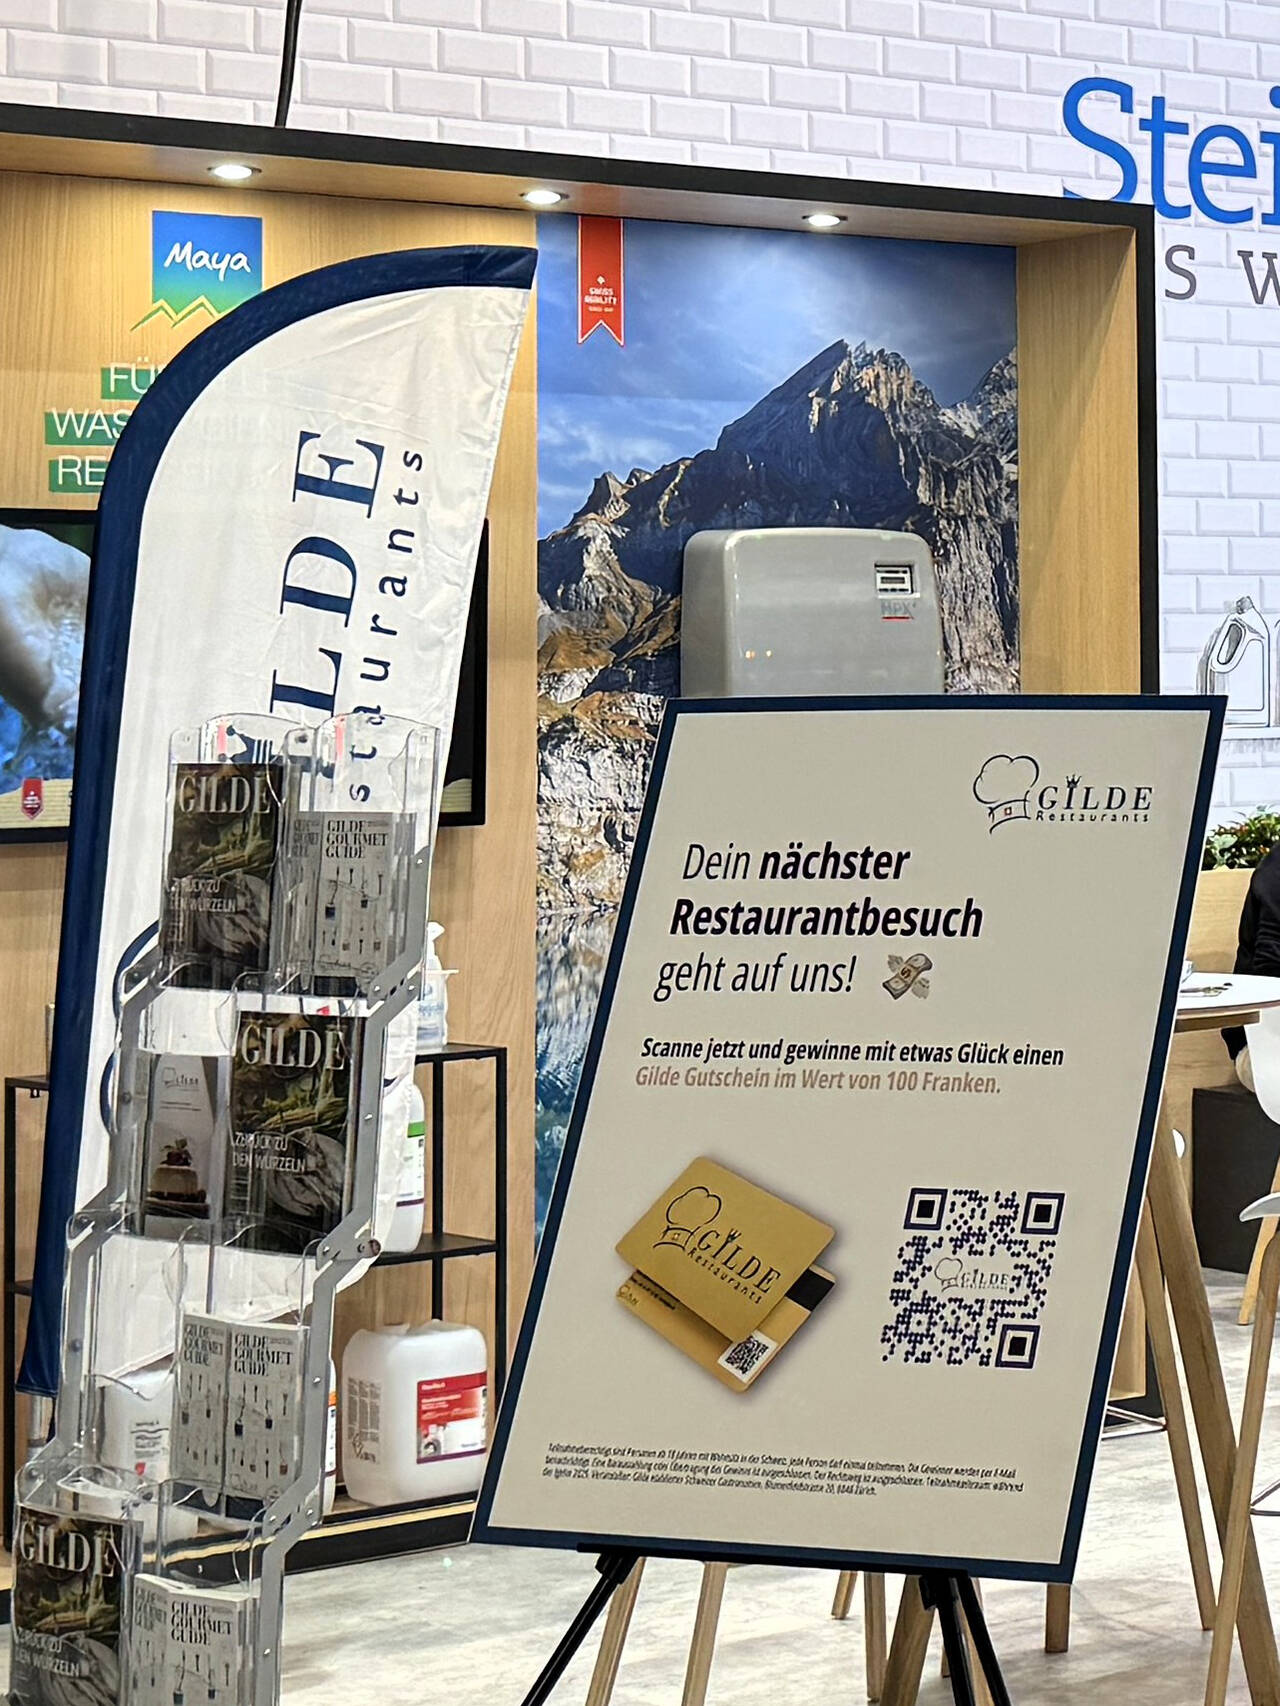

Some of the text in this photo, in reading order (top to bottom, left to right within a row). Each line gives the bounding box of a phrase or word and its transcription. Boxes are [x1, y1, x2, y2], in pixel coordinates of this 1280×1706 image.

[163, 241, 252, 282] Maya
[179, 774, 271, 815] GILDE
[1038, 777, 1153, 811] GILDE
[326, 820, 365, 833] GILDE
[1035, 810, 1149, 822] Restaurants
[325, 832, 390, 846] GOURMET
[325, 845, 365, 859] GUIDE
[682, 841, 911, 880] Dein nächster
[669, 896, 984, 938] Restaurantbesuch
[653, 951, 858, 1002] geht auf uns!
[240, 1023, 346, 1071] GILDE
[641, 1037, 1065, 1066] Scanne jetzt und gewinne mit etwas Glück einen
[635, 1065, 1001, 1094] Gilde Gutschein im Wert von 100 Franken.
[254, 1155, 306, 1173] WURZELN
[688, 1246, 773, 1305] Restaurants
[698, 1228, 782, 1294] GILDE
[234, 1332, 269, 1349] GILDE
[234, 1346, 294, 1365] GOURMET
[234, 1359, 269, 1377] GUIDE
[18, 1520, 116, 1578] GILDE
[171, 1613, 231, 1635] GOURMET
[171, 1628, 211, 1646] GUIDE
